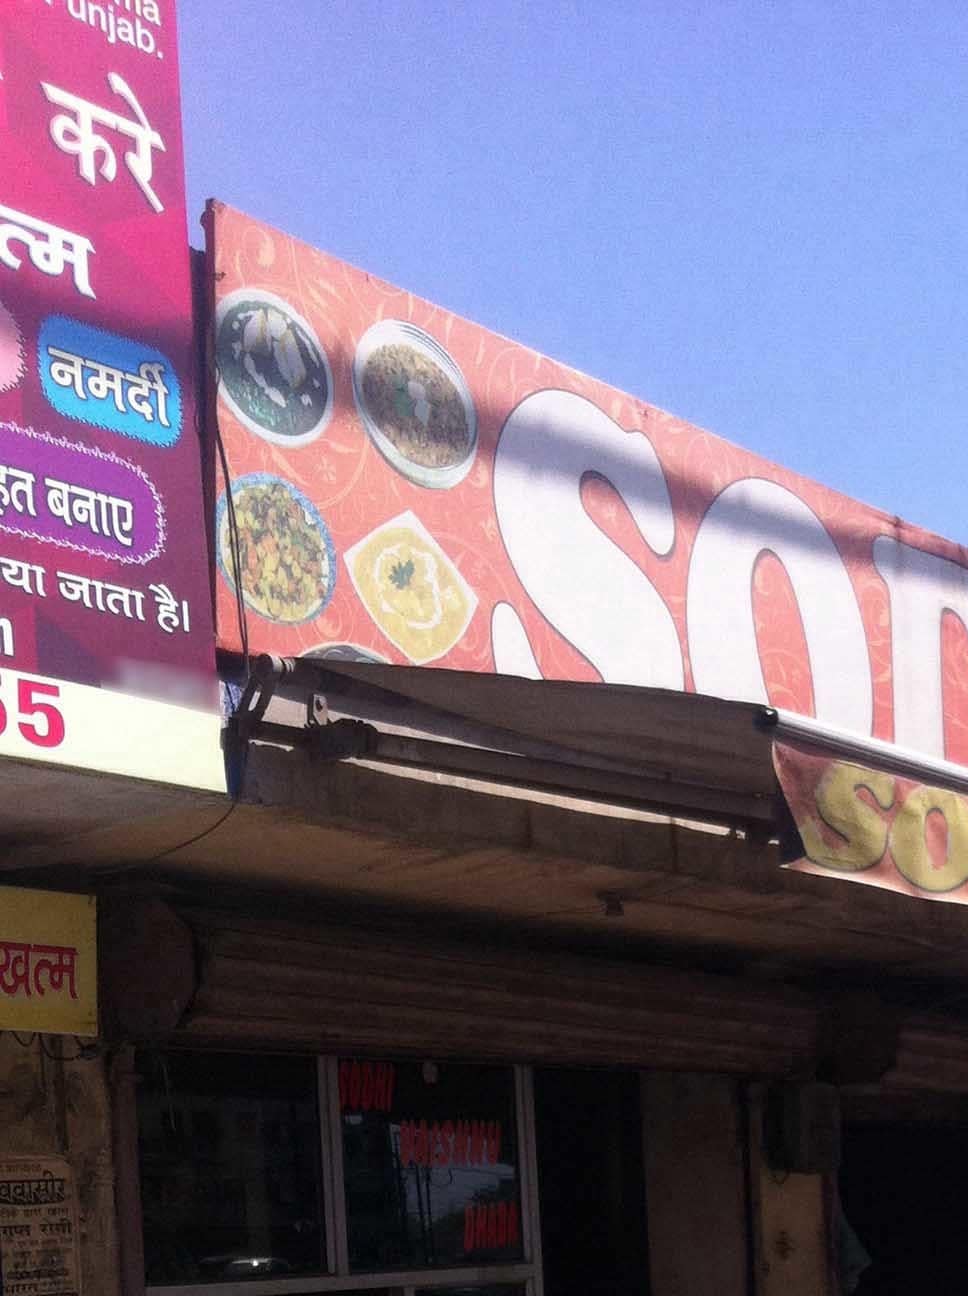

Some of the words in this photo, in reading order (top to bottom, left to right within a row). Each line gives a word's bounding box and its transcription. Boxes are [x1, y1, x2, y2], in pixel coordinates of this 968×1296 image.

[40, 71, 167, 214] करे
[44, 477, 134, 546] बनाए
[57, 571, 146, 621] जाता
